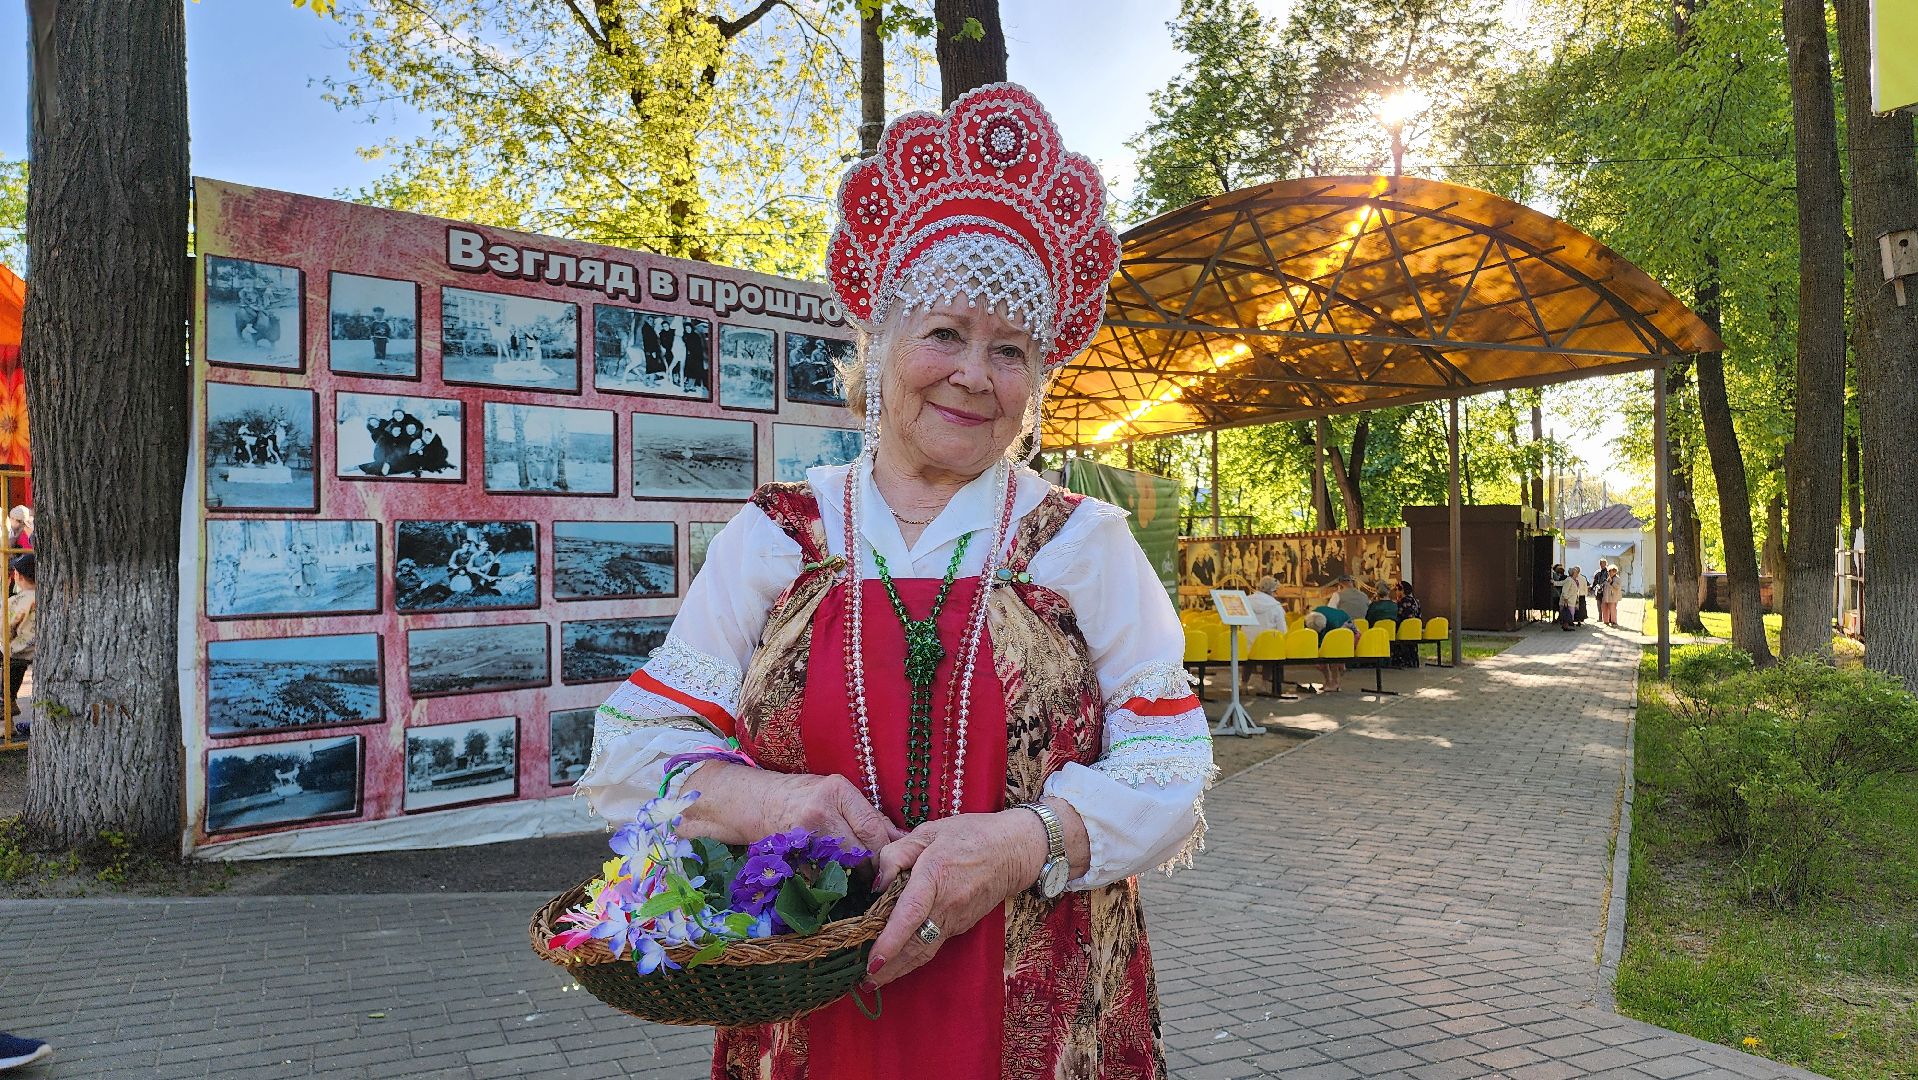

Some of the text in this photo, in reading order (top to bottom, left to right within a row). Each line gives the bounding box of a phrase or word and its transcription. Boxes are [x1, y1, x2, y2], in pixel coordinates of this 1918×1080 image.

[447, 226, 854, 327] Взгляд в прошло
